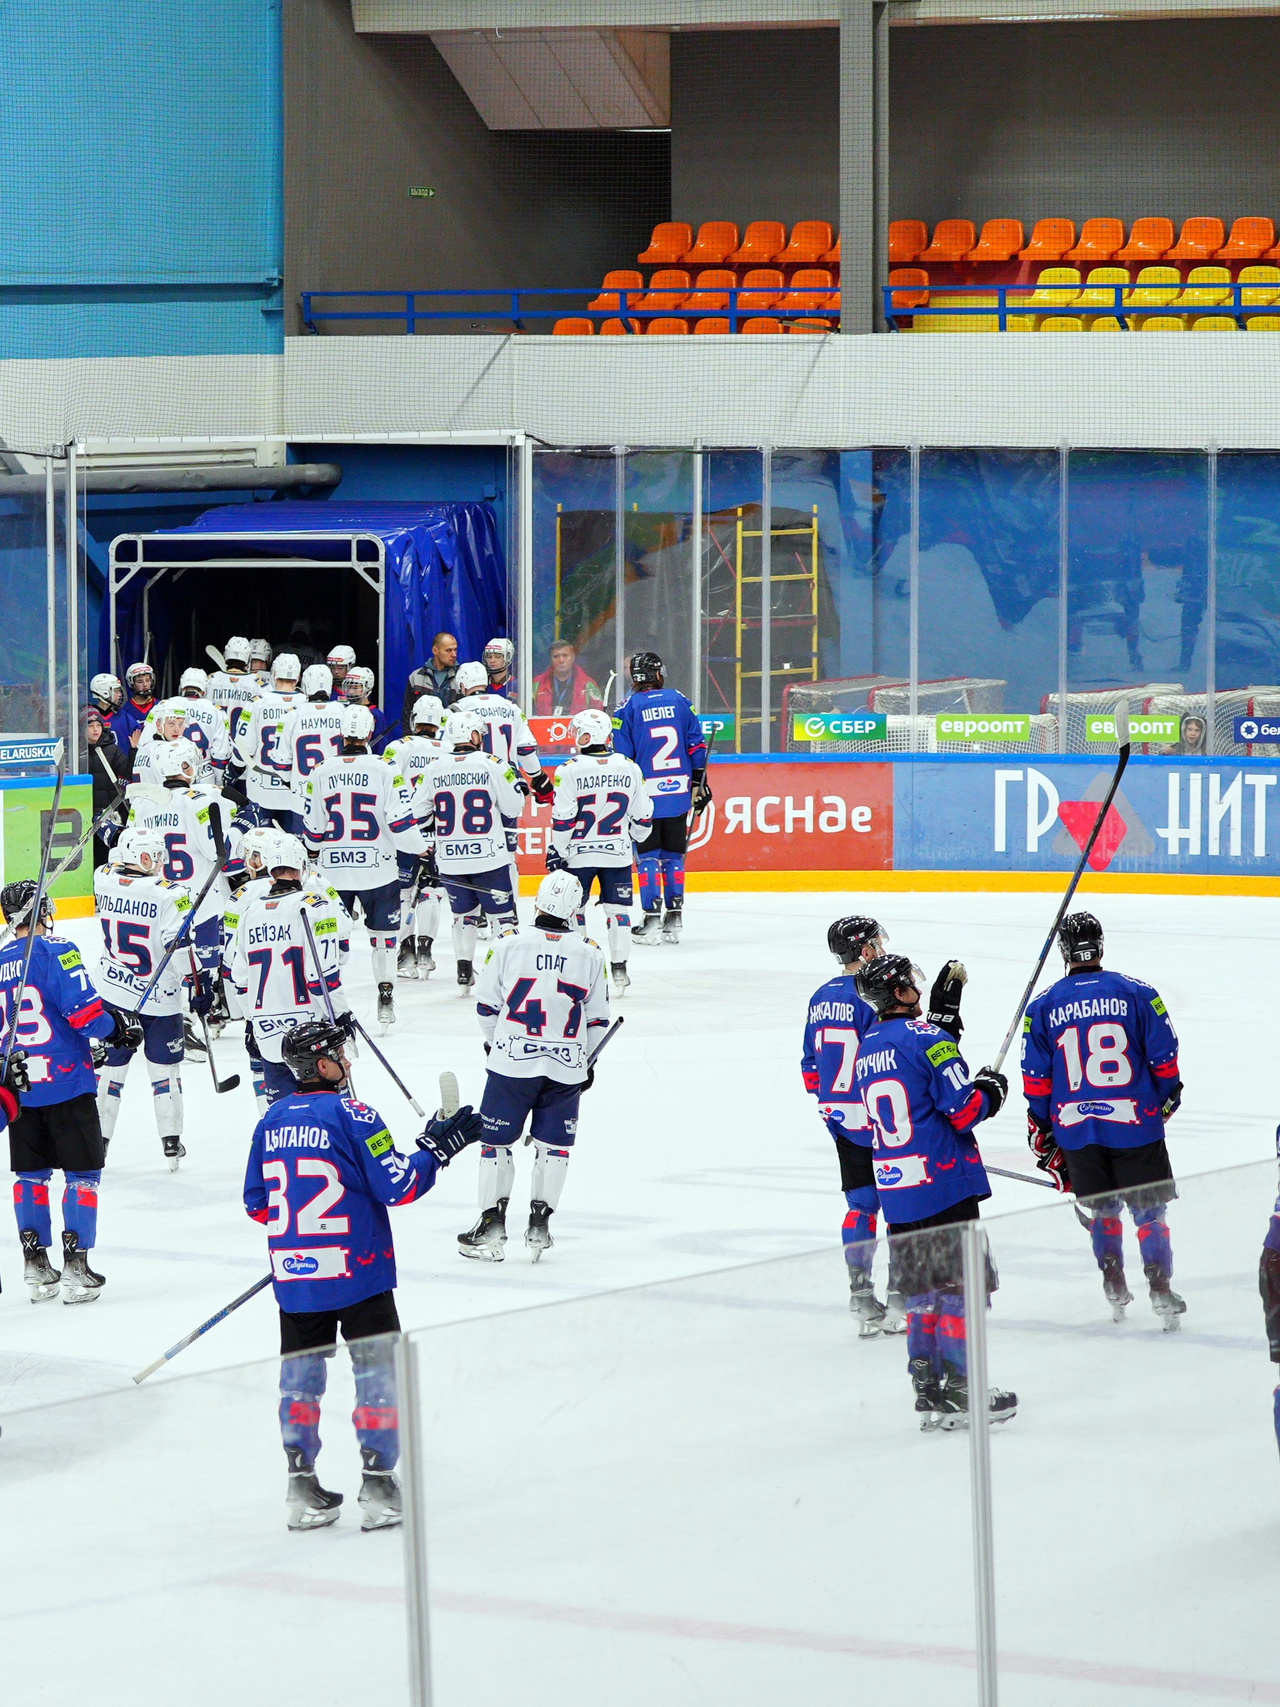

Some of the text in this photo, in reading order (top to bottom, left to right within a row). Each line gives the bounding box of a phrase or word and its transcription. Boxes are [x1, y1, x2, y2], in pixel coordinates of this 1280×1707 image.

[301, 717, 341, 730] НАУМОВ
[642, 705, 676, 723] ШЕЛЕГ
[829, 720, 877, 735] СБЕР
[940, 720, 1025, 737] евроопт
[1090, 720, 1175, 737] евоопт
[650, 726, 682, 771] 2
[324, 792, 380, 842] 55
[434, 789, 493, 836] 98
[571, 792, 629, 840] 52
[330, 851, 367, 864] БМЗ
[446, 843, 482, 856] БМЗ
[248, 922, 292, 945] БЕЙЗАК
[536, 953, 568, 974] СПАТ
[1079, 951, 1092, 962] 18
[248, 946, 311, 1010] 71
[506, 977, 589, 1039] 47
[1049, 998, 1129, 1029] КАРАБАНОВ
[1057, 1022, 1133, 1092] 18
[263, 1157, 349, 1237] 32
